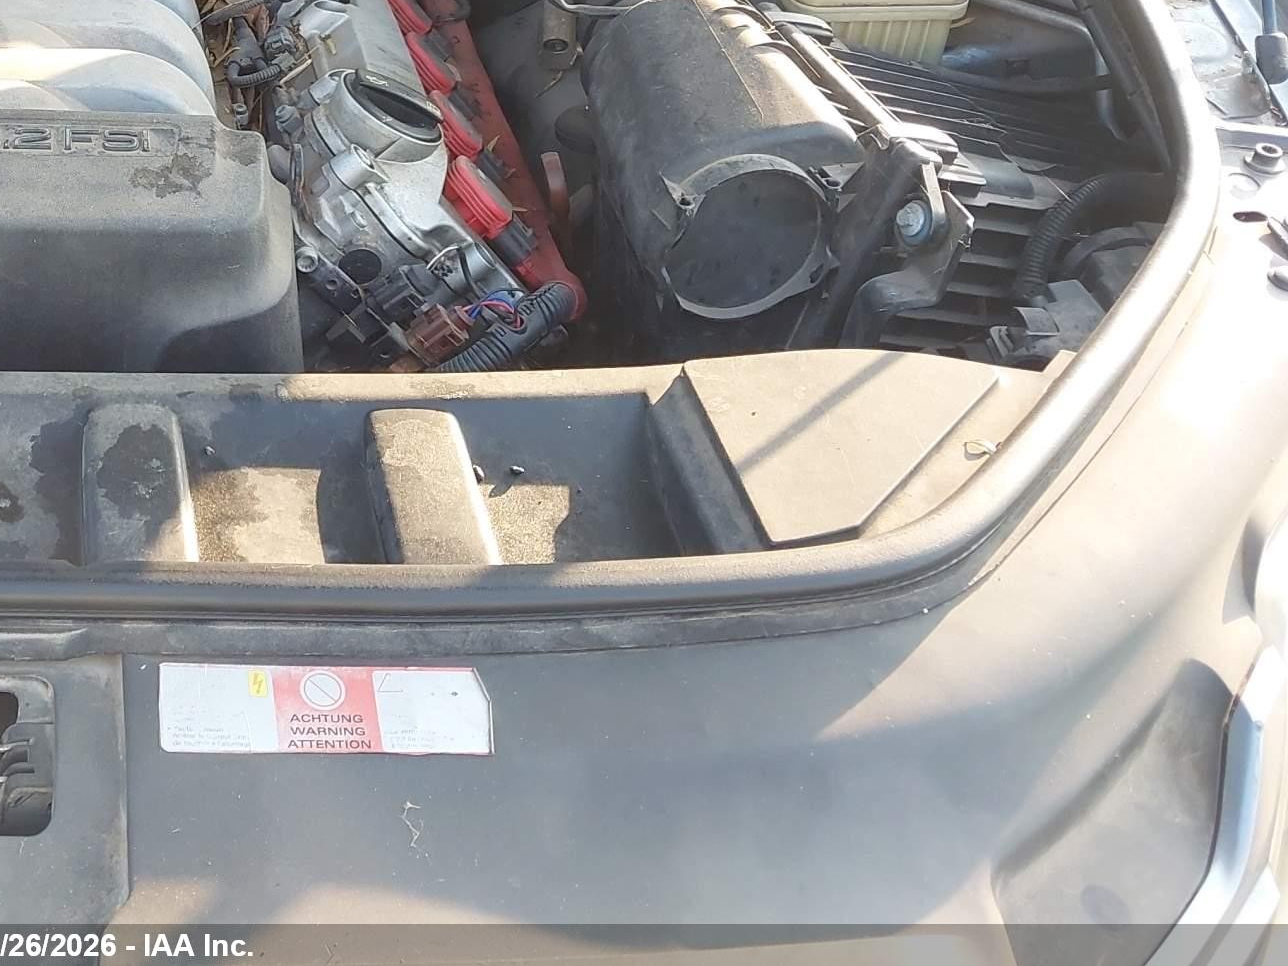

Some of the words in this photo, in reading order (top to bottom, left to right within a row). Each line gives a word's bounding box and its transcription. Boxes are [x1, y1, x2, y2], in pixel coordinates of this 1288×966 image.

[289, 713, 364, 723] ACHTUNG
[289, 726, 366, 736] WARNING
[287, 739, 372, 750] ATTENTION
